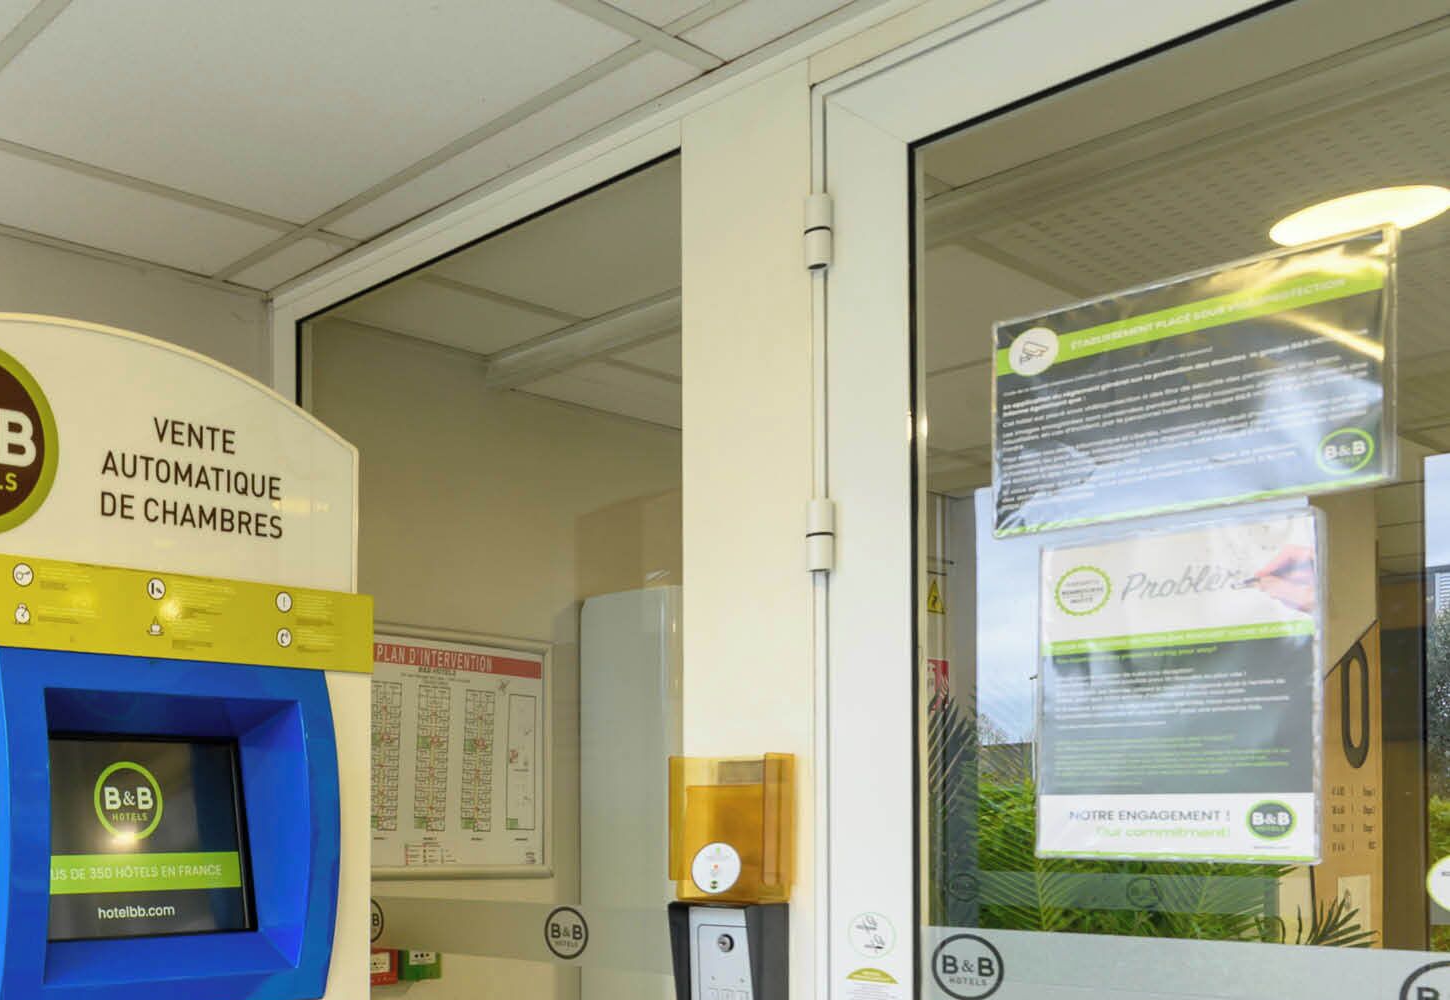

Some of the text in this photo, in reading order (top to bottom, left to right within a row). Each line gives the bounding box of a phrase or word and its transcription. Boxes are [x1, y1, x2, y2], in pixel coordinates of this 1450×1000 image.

[154, 417, 236, 455] VENTE
[1325, 439, 1367, 461] B&B
[101, 451, 282, 501] AUTOMATIQUE
[100, 492, 283, 540] DE CHAMBRES
[377, 644, 493, 673] PLAN D'INTERVENTION
[104, 786, 153, 810] B&B
[112, 812, 149, 821] HOTELS
[1069, 810, 1114, 821] NOTRE
[1119, 809, 1222, 821] ENGAGEMENT
[1252, 811, 1291, 826] B&B
[70, 868, 86, 880] DE
[89, 866, 113, 880] 350
[115, 864, 159, 879] HÔTELS
[161, 866, 176, 877] EN
[178, 864, 223, 877] FRANCE
[98, 904, 176, 920] hotelbb.com
[551, 923, 583, 940] B&B
[941, 955, 996, 978] B&B
[949, 976, 988, 988] HOTELS
